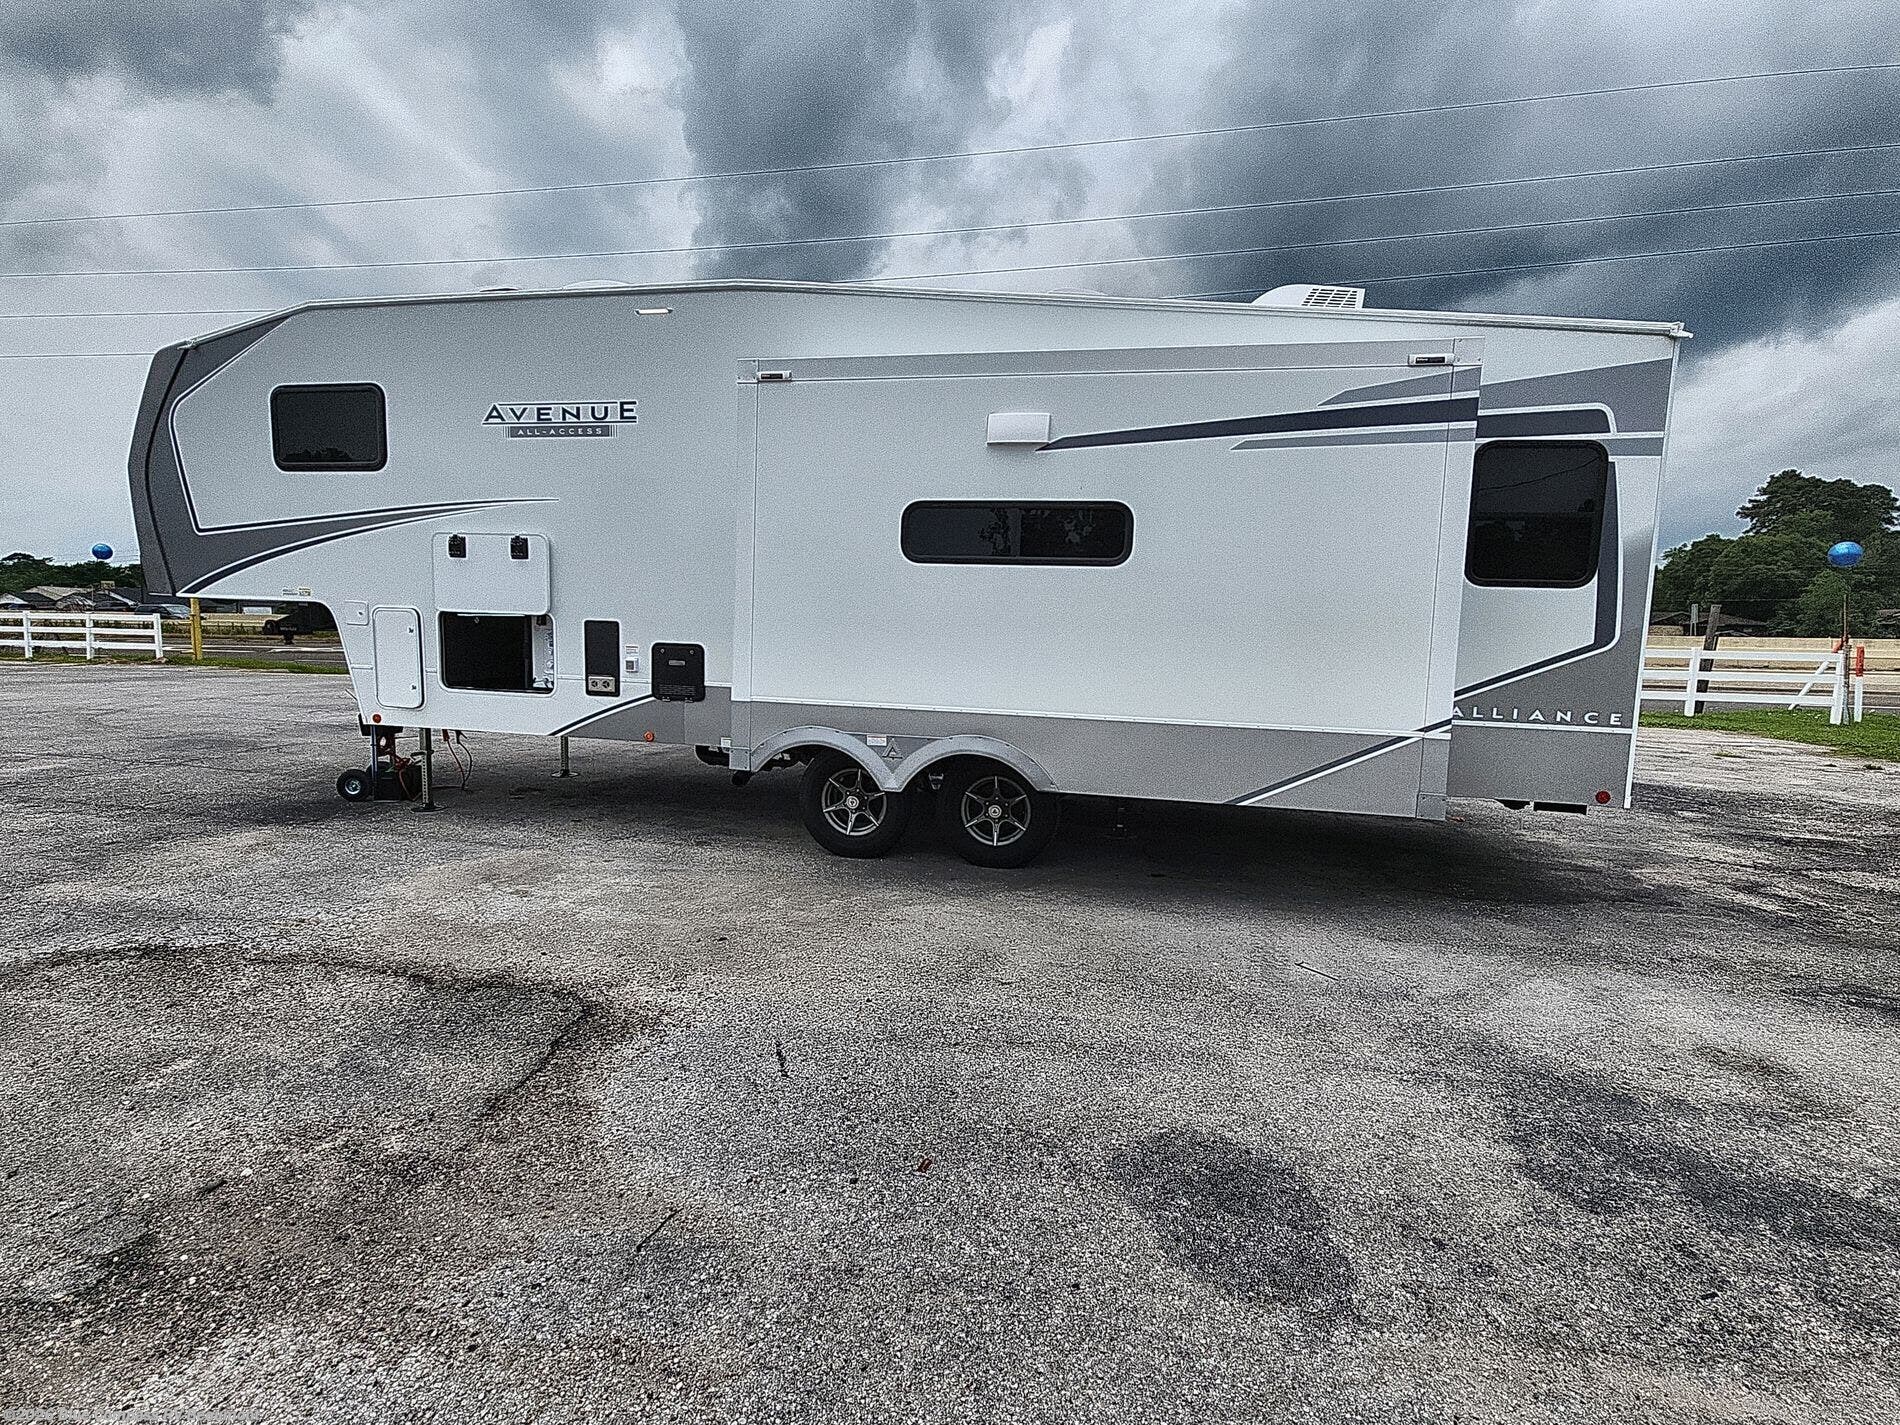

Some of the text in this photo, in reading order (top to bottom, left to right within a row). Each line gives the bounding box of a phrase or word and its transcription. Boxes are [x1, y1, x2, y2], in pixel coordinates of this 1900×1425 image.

[483, 400, 637, 422] AVENUE
[516, 427, 603, 436] ALL-ACCESS
[1452, 706, 1622, 725] ALLIANCE
